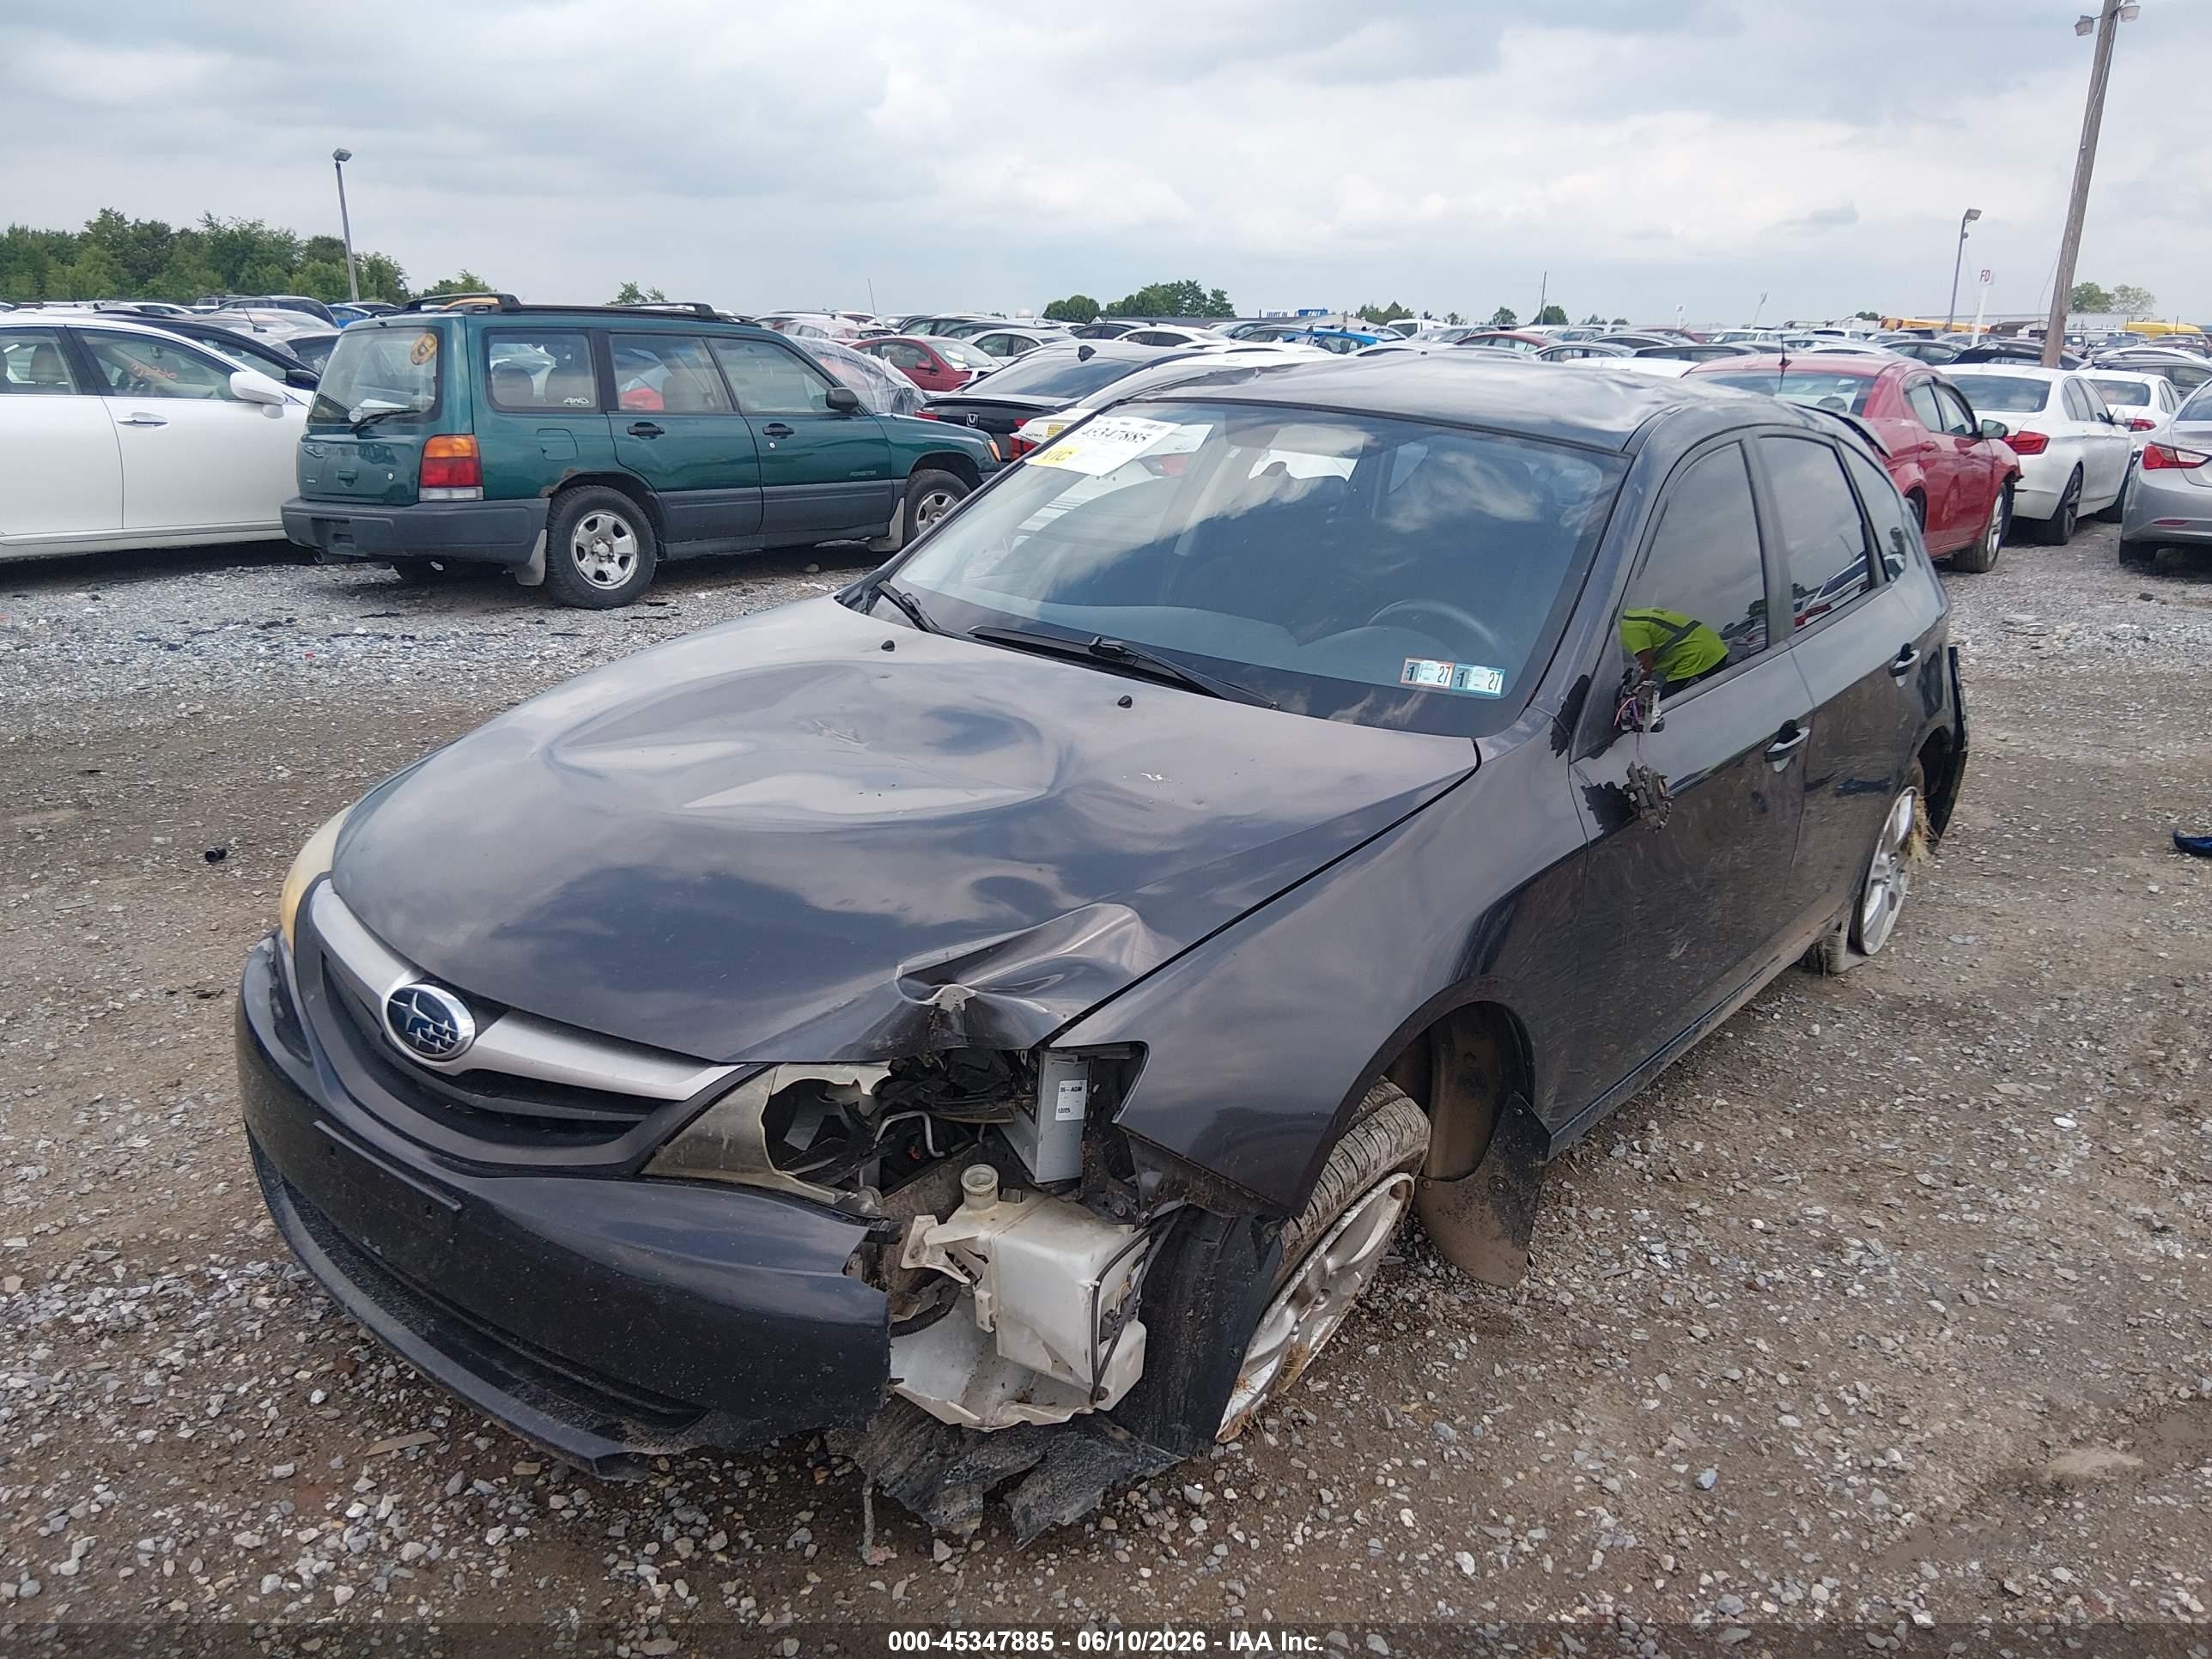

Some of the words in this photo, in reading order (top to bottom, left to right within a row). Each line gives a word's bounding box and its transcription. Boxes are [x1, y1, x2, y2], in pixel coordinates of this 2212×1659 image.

[1407, 665, 1416, 682] 1
[1437, 665, 1450, 684] 27
[1456, 672, 1465, 687] 1
[1487, 672, 1501, 691] 27
